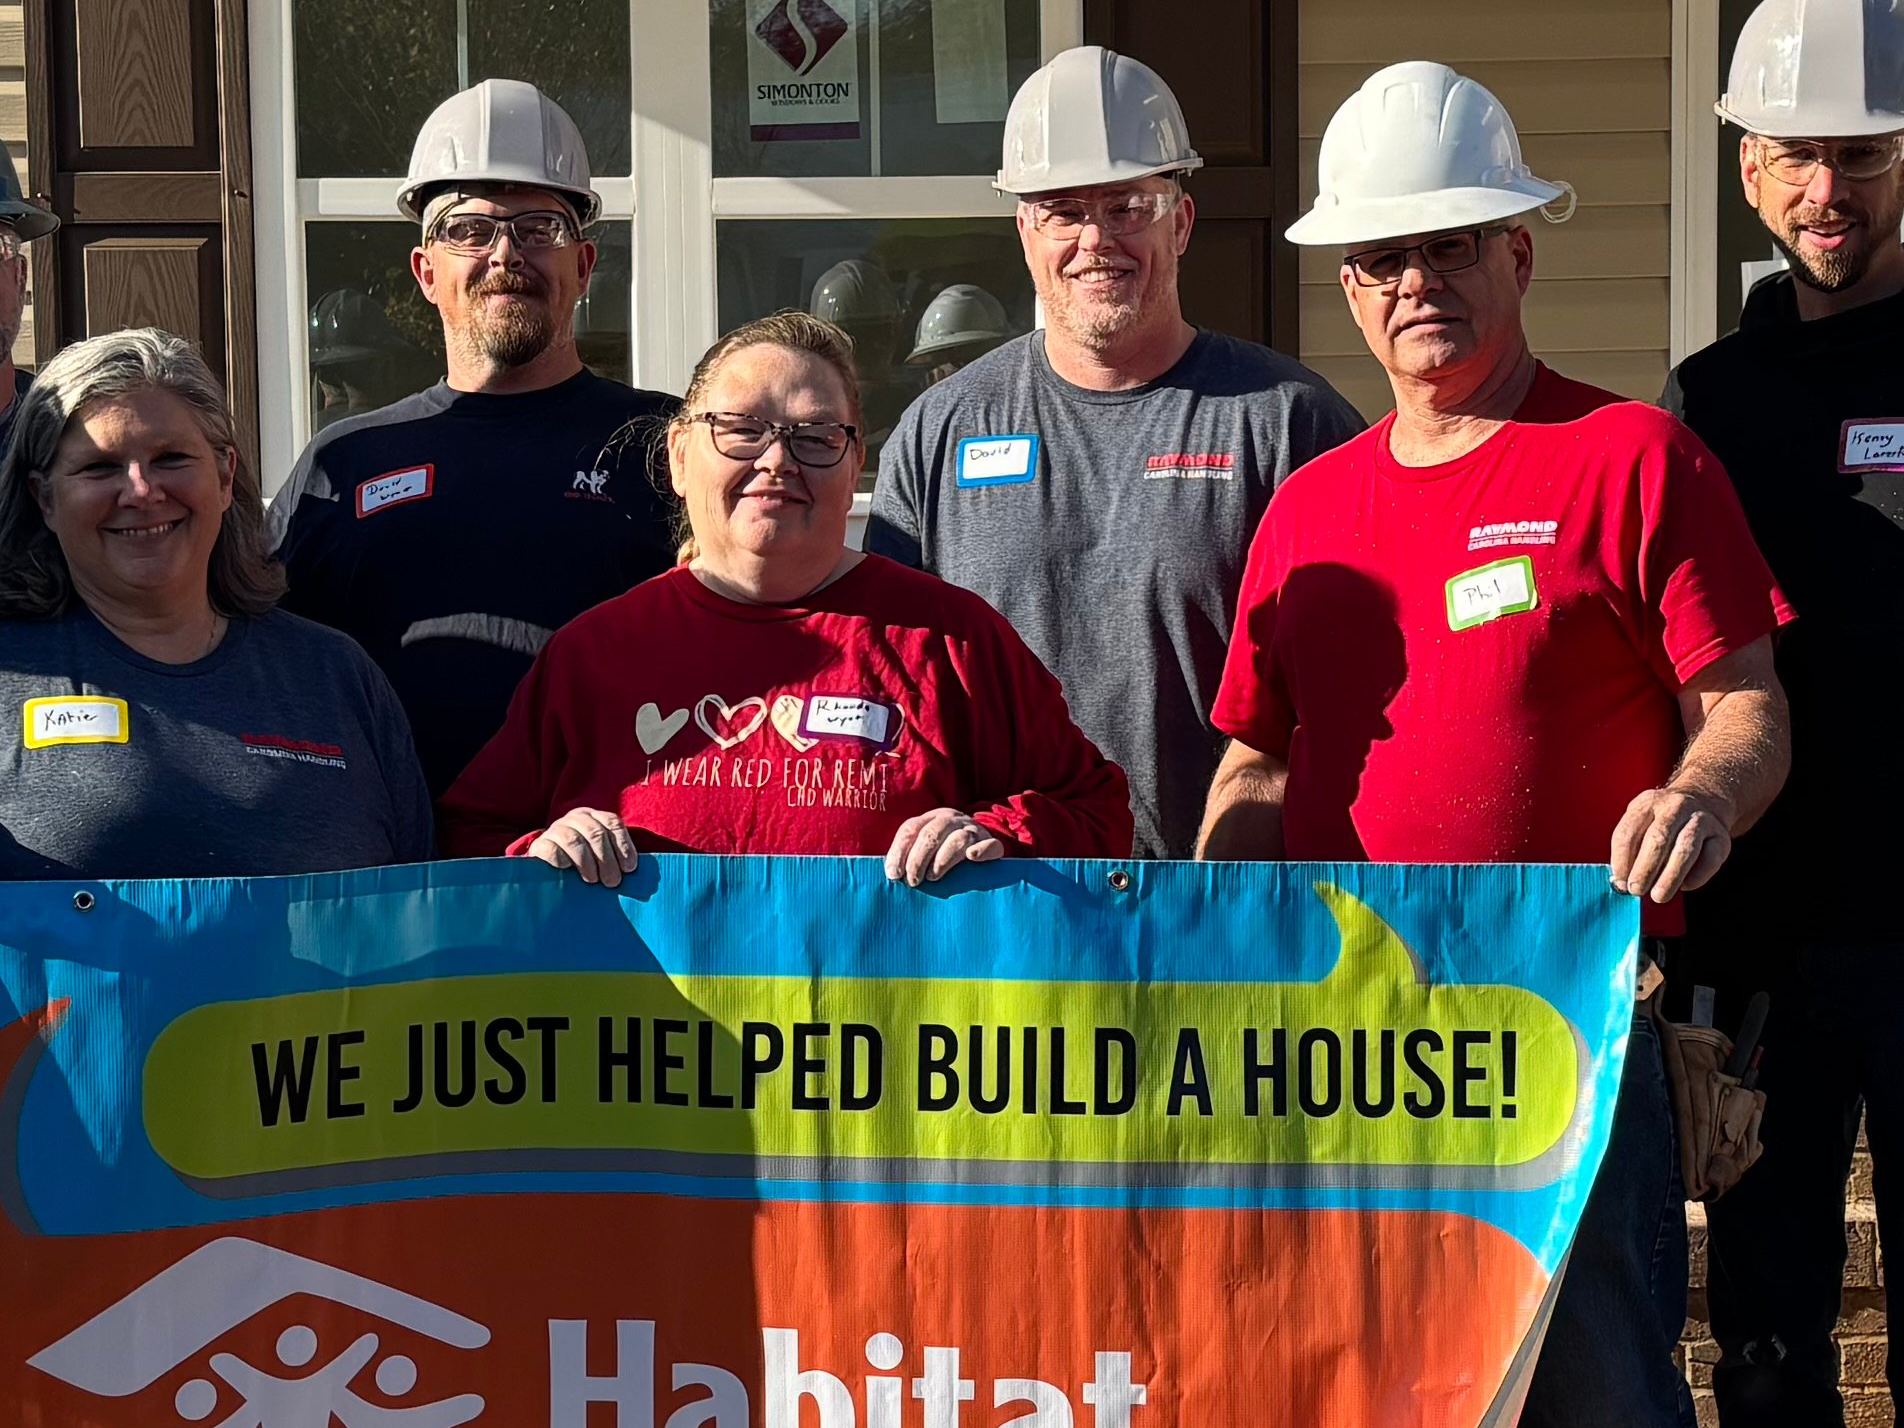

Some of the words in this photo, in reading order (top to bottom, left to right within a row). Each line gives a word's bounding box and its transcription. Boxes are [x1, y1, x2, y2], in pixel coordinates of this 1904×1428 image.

[757, 82, 849, 100] SIMONTON
[1469, 520, 1558, 539] RAYMOND
[640, 758, 652, 786] I
[663, 756, 722, 787] WEAR
[730, 757, 772, 788] RED
[783, 757, 824, 789] FOR
[833, 757, 889, 793] REMI
[787, 785, 817, 808] CHD
[822, 788, 887, 812] WARRIOR
[249, 1029, 366, 1128] WE
[392, 1016, 570, 1114] JUST
[597, 1016, 884, 1112] HELPED
[916, 1022, 1138, 1117] BUILD
[1165, 1026, 1214, 1118] A
[1242, 1026, 1519, 1120] HOUSE!
